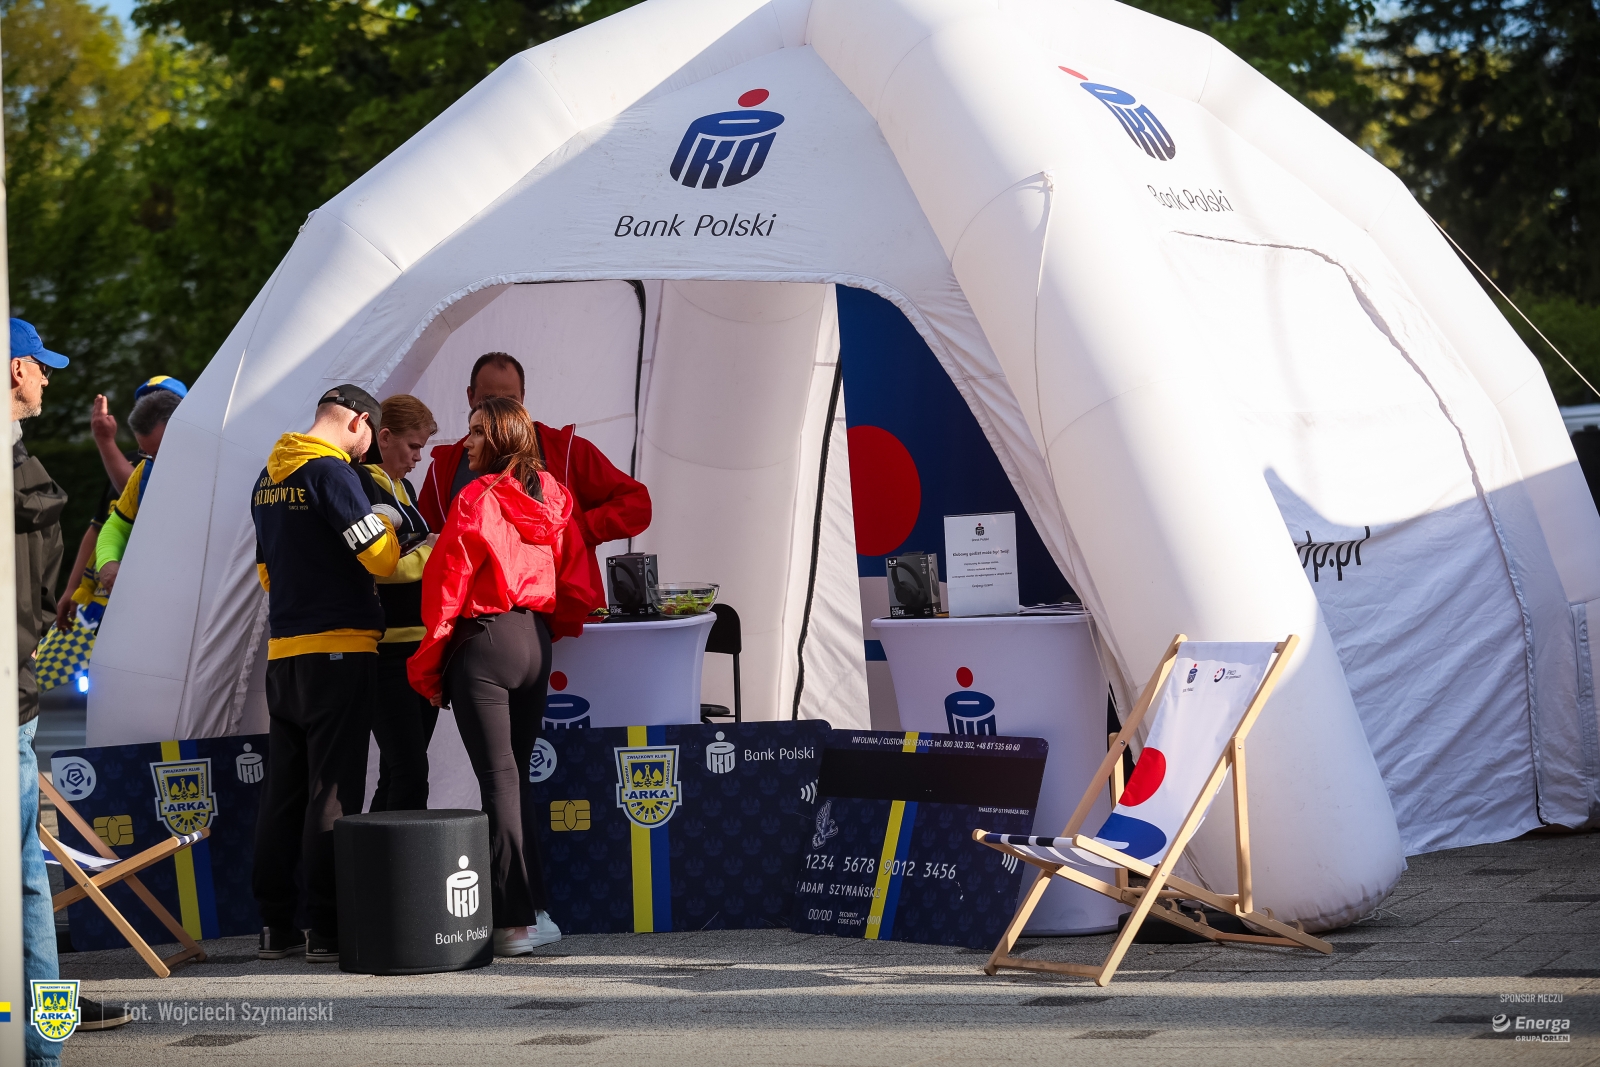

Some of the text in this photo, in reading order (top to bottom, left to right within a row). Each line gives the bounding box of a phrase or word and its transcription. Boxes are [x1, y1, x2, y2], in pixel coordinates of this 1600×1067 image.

[669, 109, 785, 189] PKO
[1146, 184, 1234, 213] Bank Polski
[614, 212, 777, 237] Bank Polski
[342, 513, 386, 550] PUM
[744, 746, 814, 761] Bank Polski
[883, 738, 912, 746] CUSTOMER
[912, 739, 934, 747] SERVICE
[953, 741, 964, 749] 302
[236, 752, 264, 784] PKO
[706, 741, 735, 774] PKO
[167, 801, 207, 813] ARKA
[628, 789, 670, 800] ARKA
[805, 854, 957, 880] 1234 5678 9012 3456
[446, 870, 480, 918] PKO
[800, 881, 881, 898] ADAM SZYMAŃSKI
[808, 908, 833, 922] 00/00
[435, 925, 488, 945] Bank Polski
